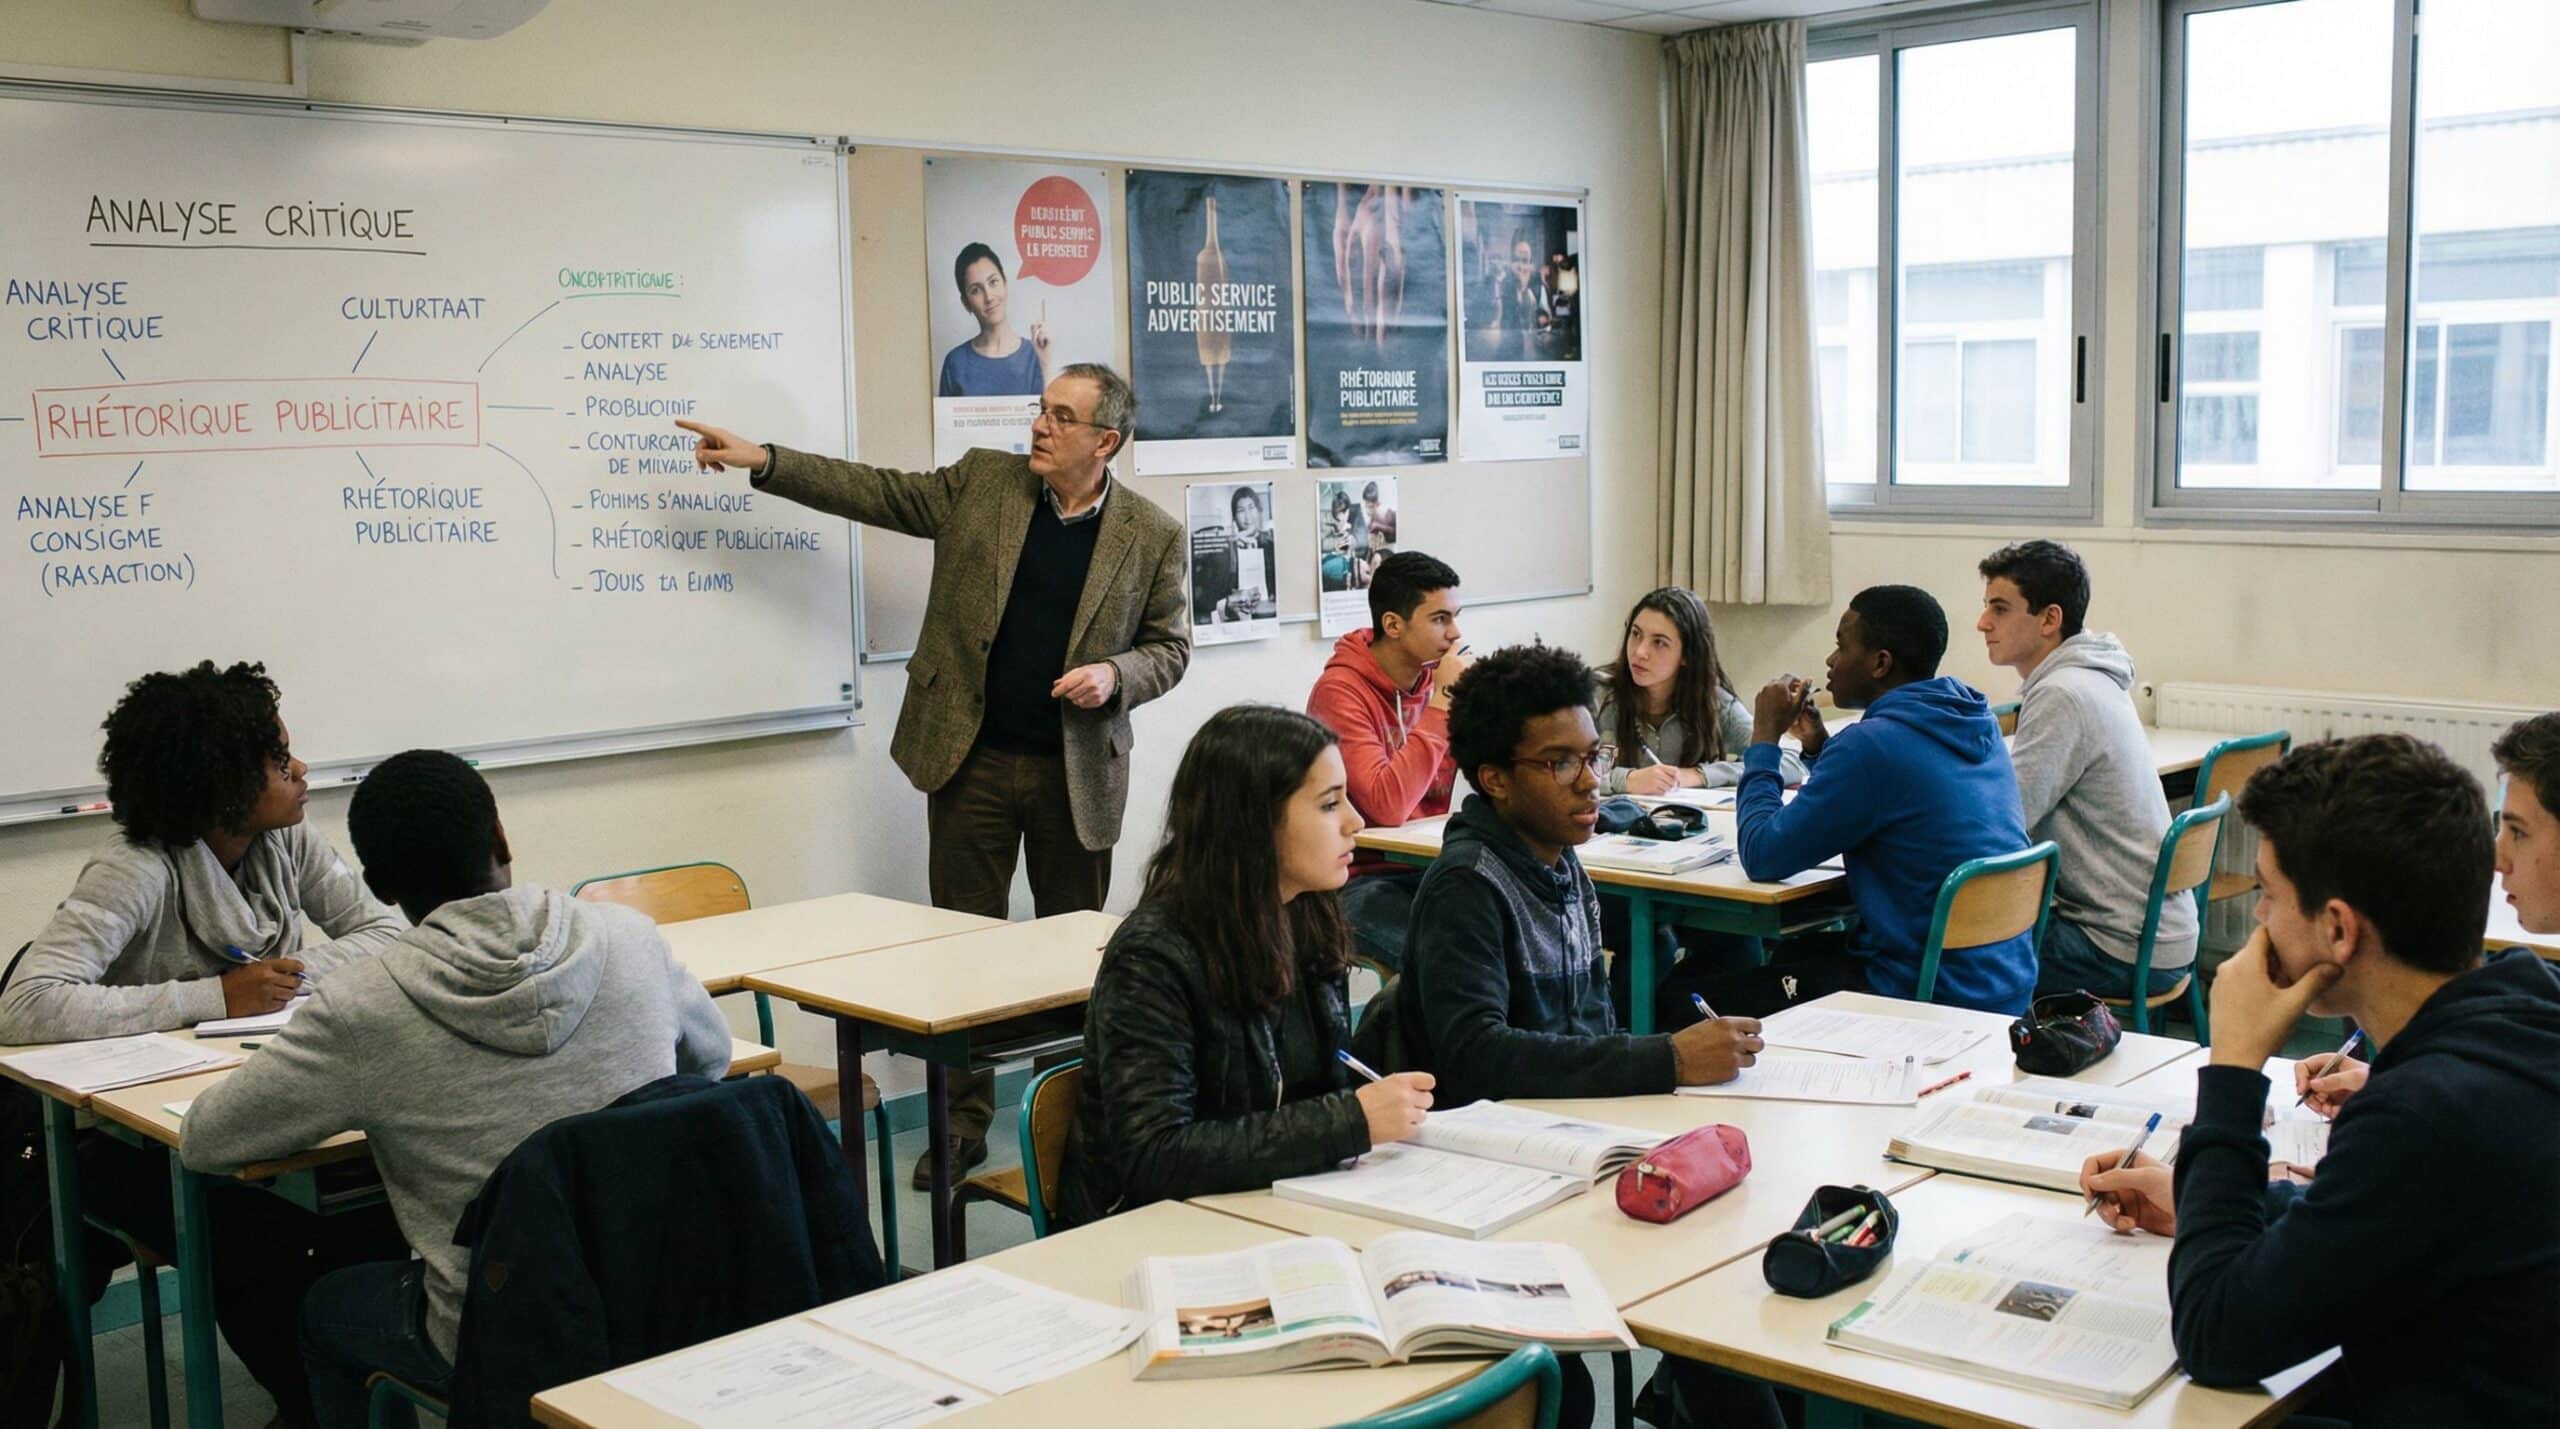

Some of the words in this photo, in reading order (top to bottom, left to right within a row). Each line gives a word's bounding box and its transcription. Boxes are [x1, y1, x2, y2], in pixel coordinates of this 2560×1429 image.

[86, 194, 237, 241] ANALYSE
[264, 201, 415, 241] CRITIQUE
[7, 279, 128, 311] ANALYSE
[342, 296, 487, 320] CULTURTAAT
[1146, 280, 1206, 306] PUBLIC
[1210, 282, 1277, 308] SERVICE
[27, 312, 164, 342] CRITIQUE
[1147, 308, 1277, 333] ADVERTISEMENT
[581, 331, 662, 350] CONTERT
[583, 362, 668, 385] ANALYSE
[1340, 389, 1418, 407] PUBLICITAIRE
[48, 393, 253, 441] RHÉTORIQUE
[276, 395, 465, 433] PUBLICITAIRE
[608, 458, 630, 475] DE
[17, 493, 127, 521] ANALYSE
[140, 494, 155, 516] F
[343, 477, 483, 510] RHÉTORIQUE
[657, 490, 753, 513] S'ANALIQUE
[355, 516, 499, 544] PUBLICITAIRE
[592, 521, 708, 551] RHÉTORIQUE
[716, 527, 820, 551] PUBLICITAIRE
[41, 552, 195, 597] (RASACTION)
[589, 569, 645, 593] JOUIS
